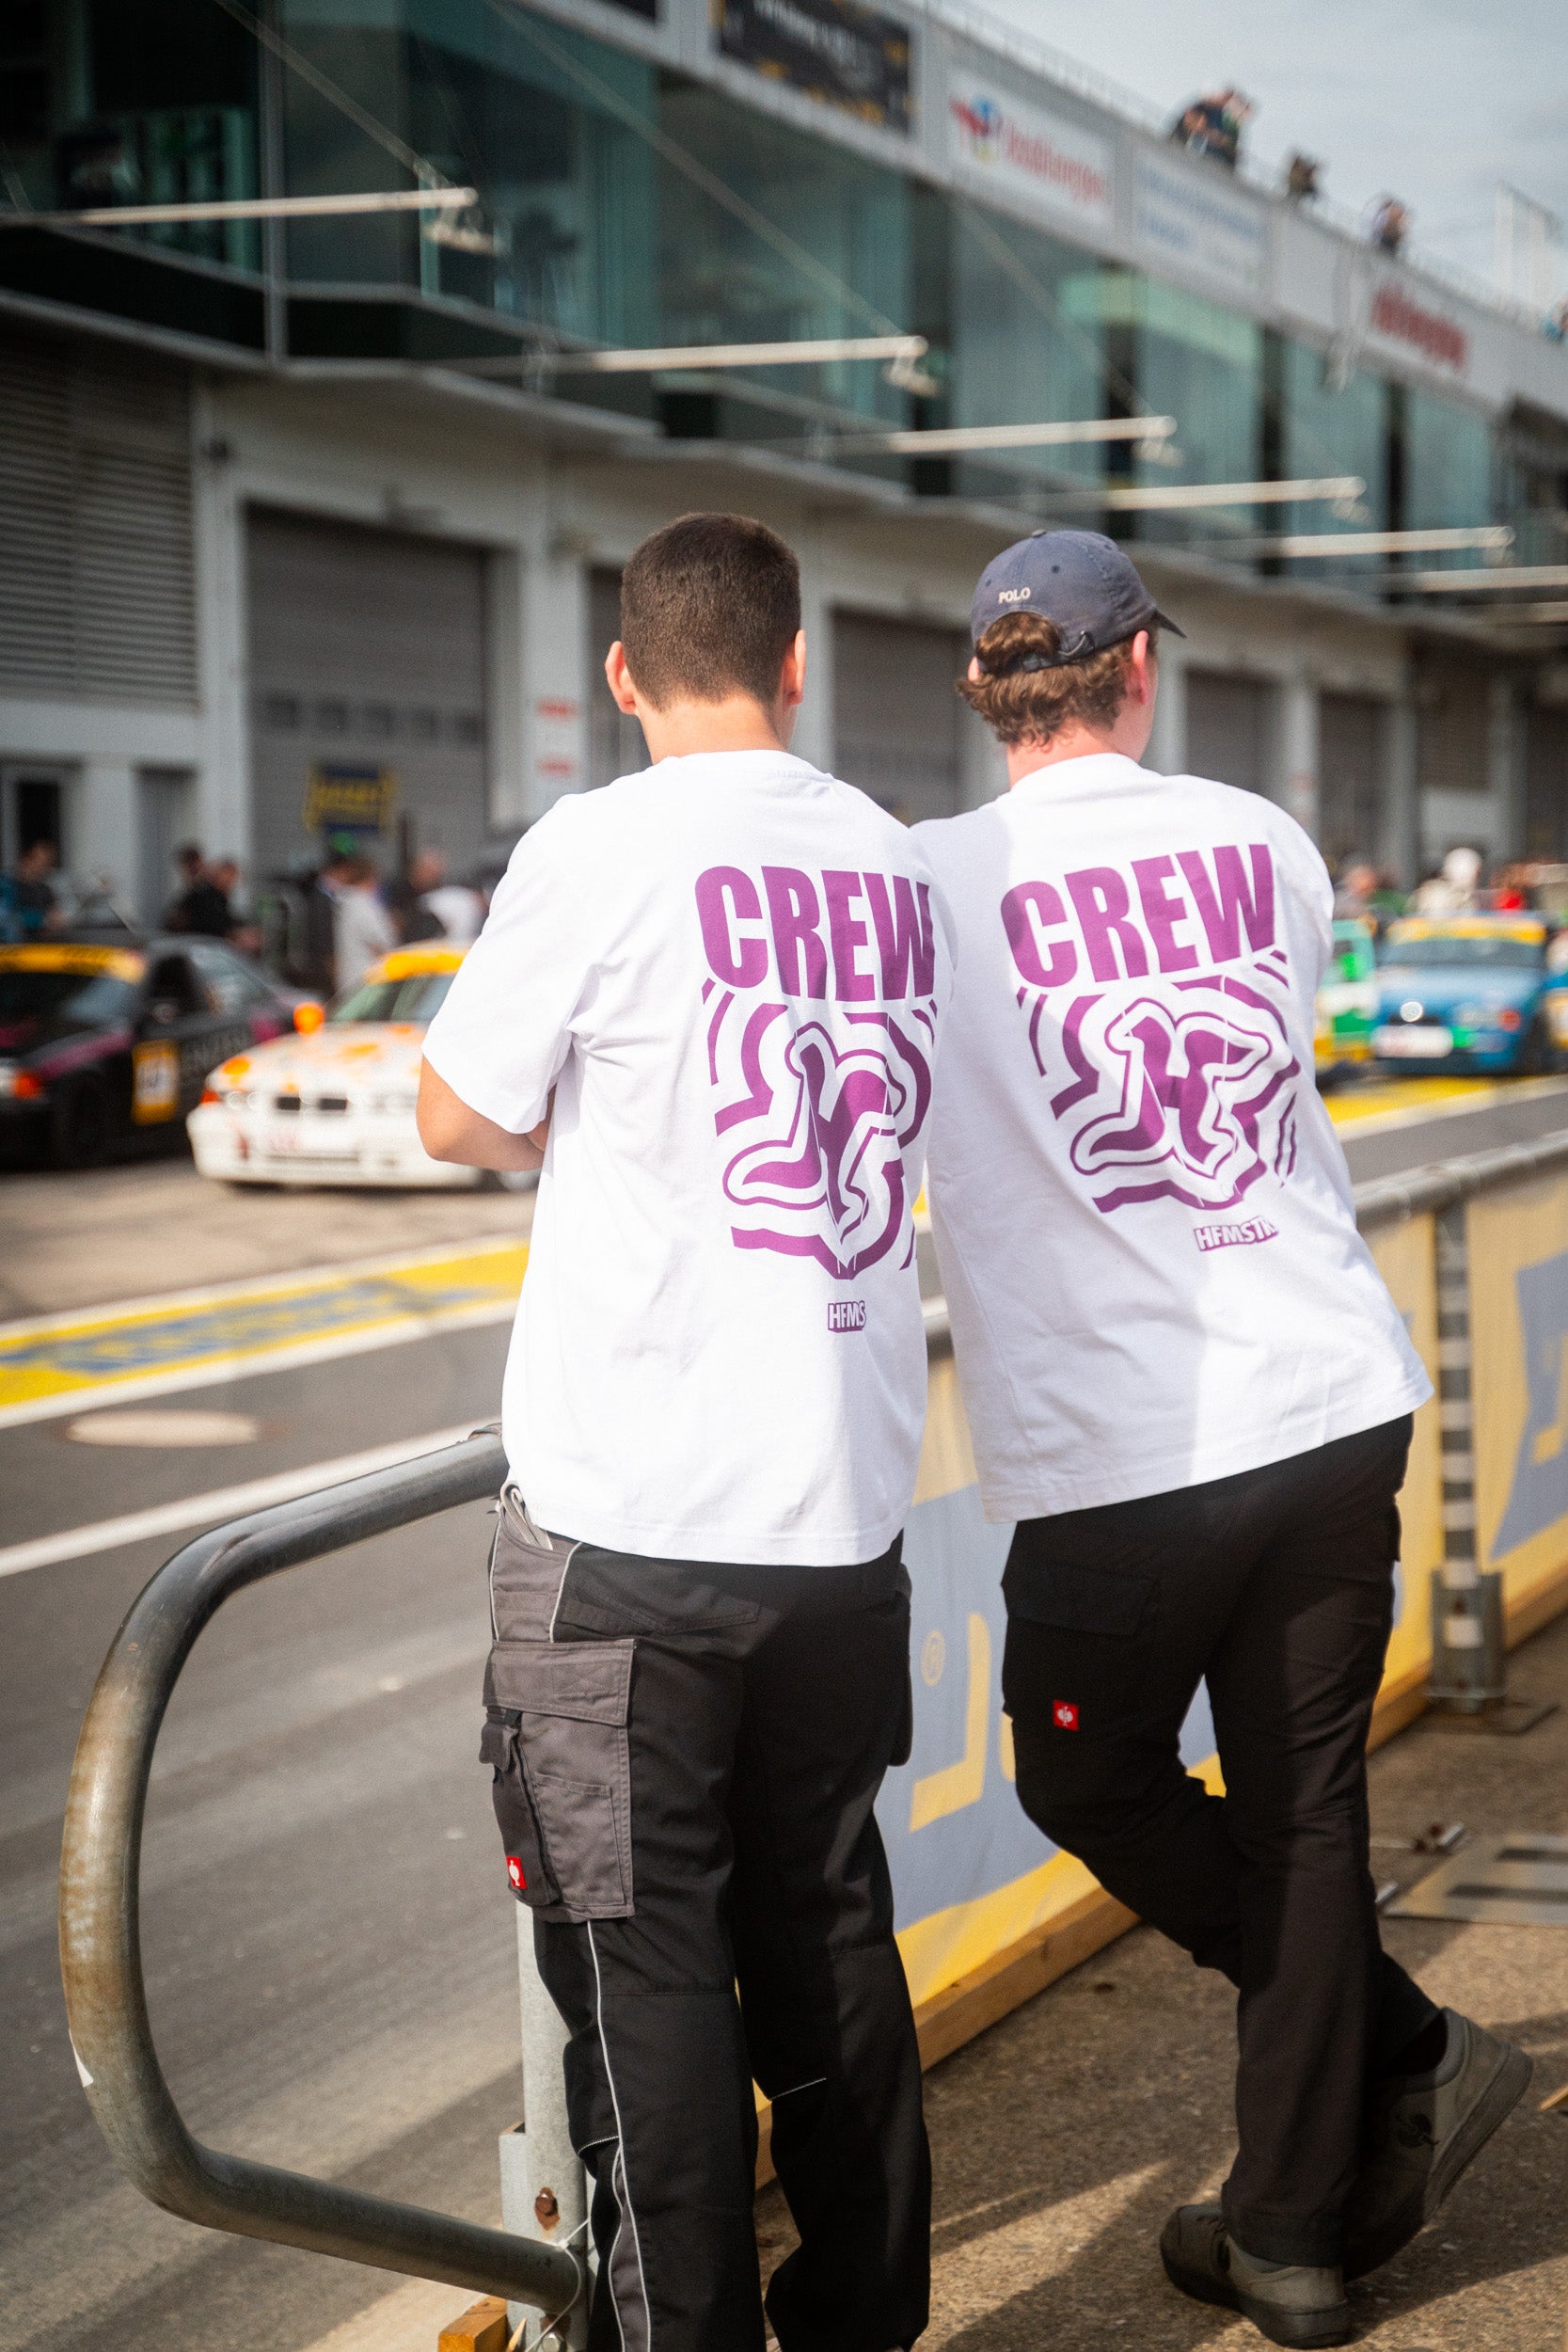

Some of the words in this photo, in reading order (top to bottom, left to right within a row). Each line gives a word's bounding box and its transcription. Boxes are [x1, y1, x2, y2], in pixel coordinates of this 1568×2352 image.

[999, 587, 1031, 604] POLO
[695, 866, 935, 1001] CREW
[1001, 844, 1275, 988] CREW
